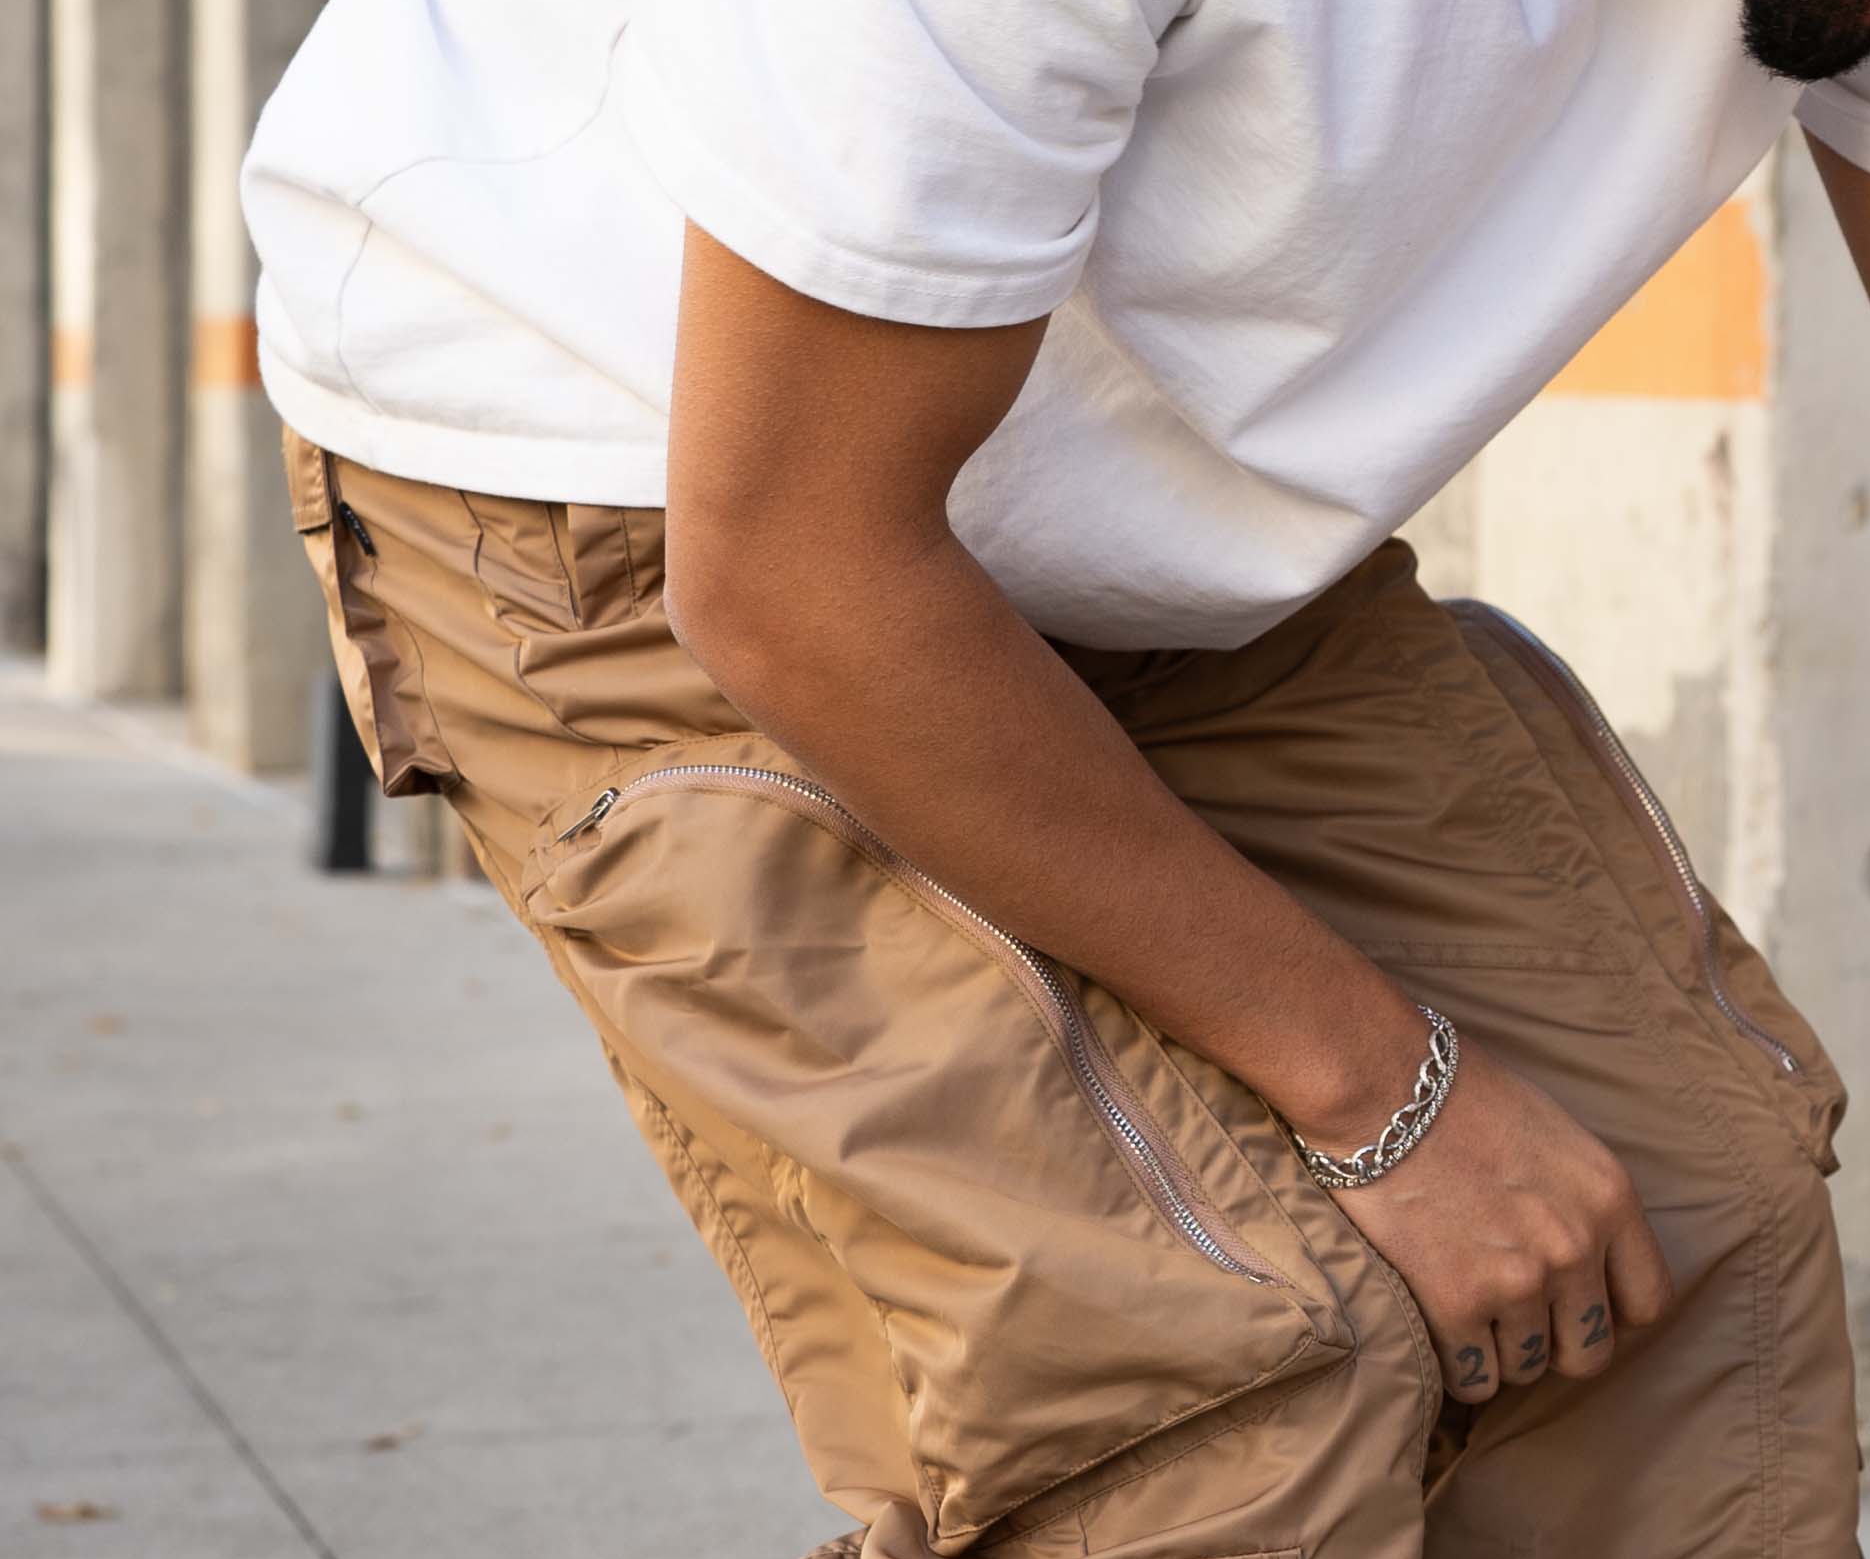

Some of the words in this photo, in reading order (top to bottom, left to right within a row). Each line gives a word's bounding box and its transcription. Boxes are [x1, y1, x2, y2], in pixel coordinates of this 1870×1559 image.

[1456, 1345, 1489, 1387] 2
[1519, 1329, 1547, 1371] 2
[1580, 1304, 1609, 1349] 2
